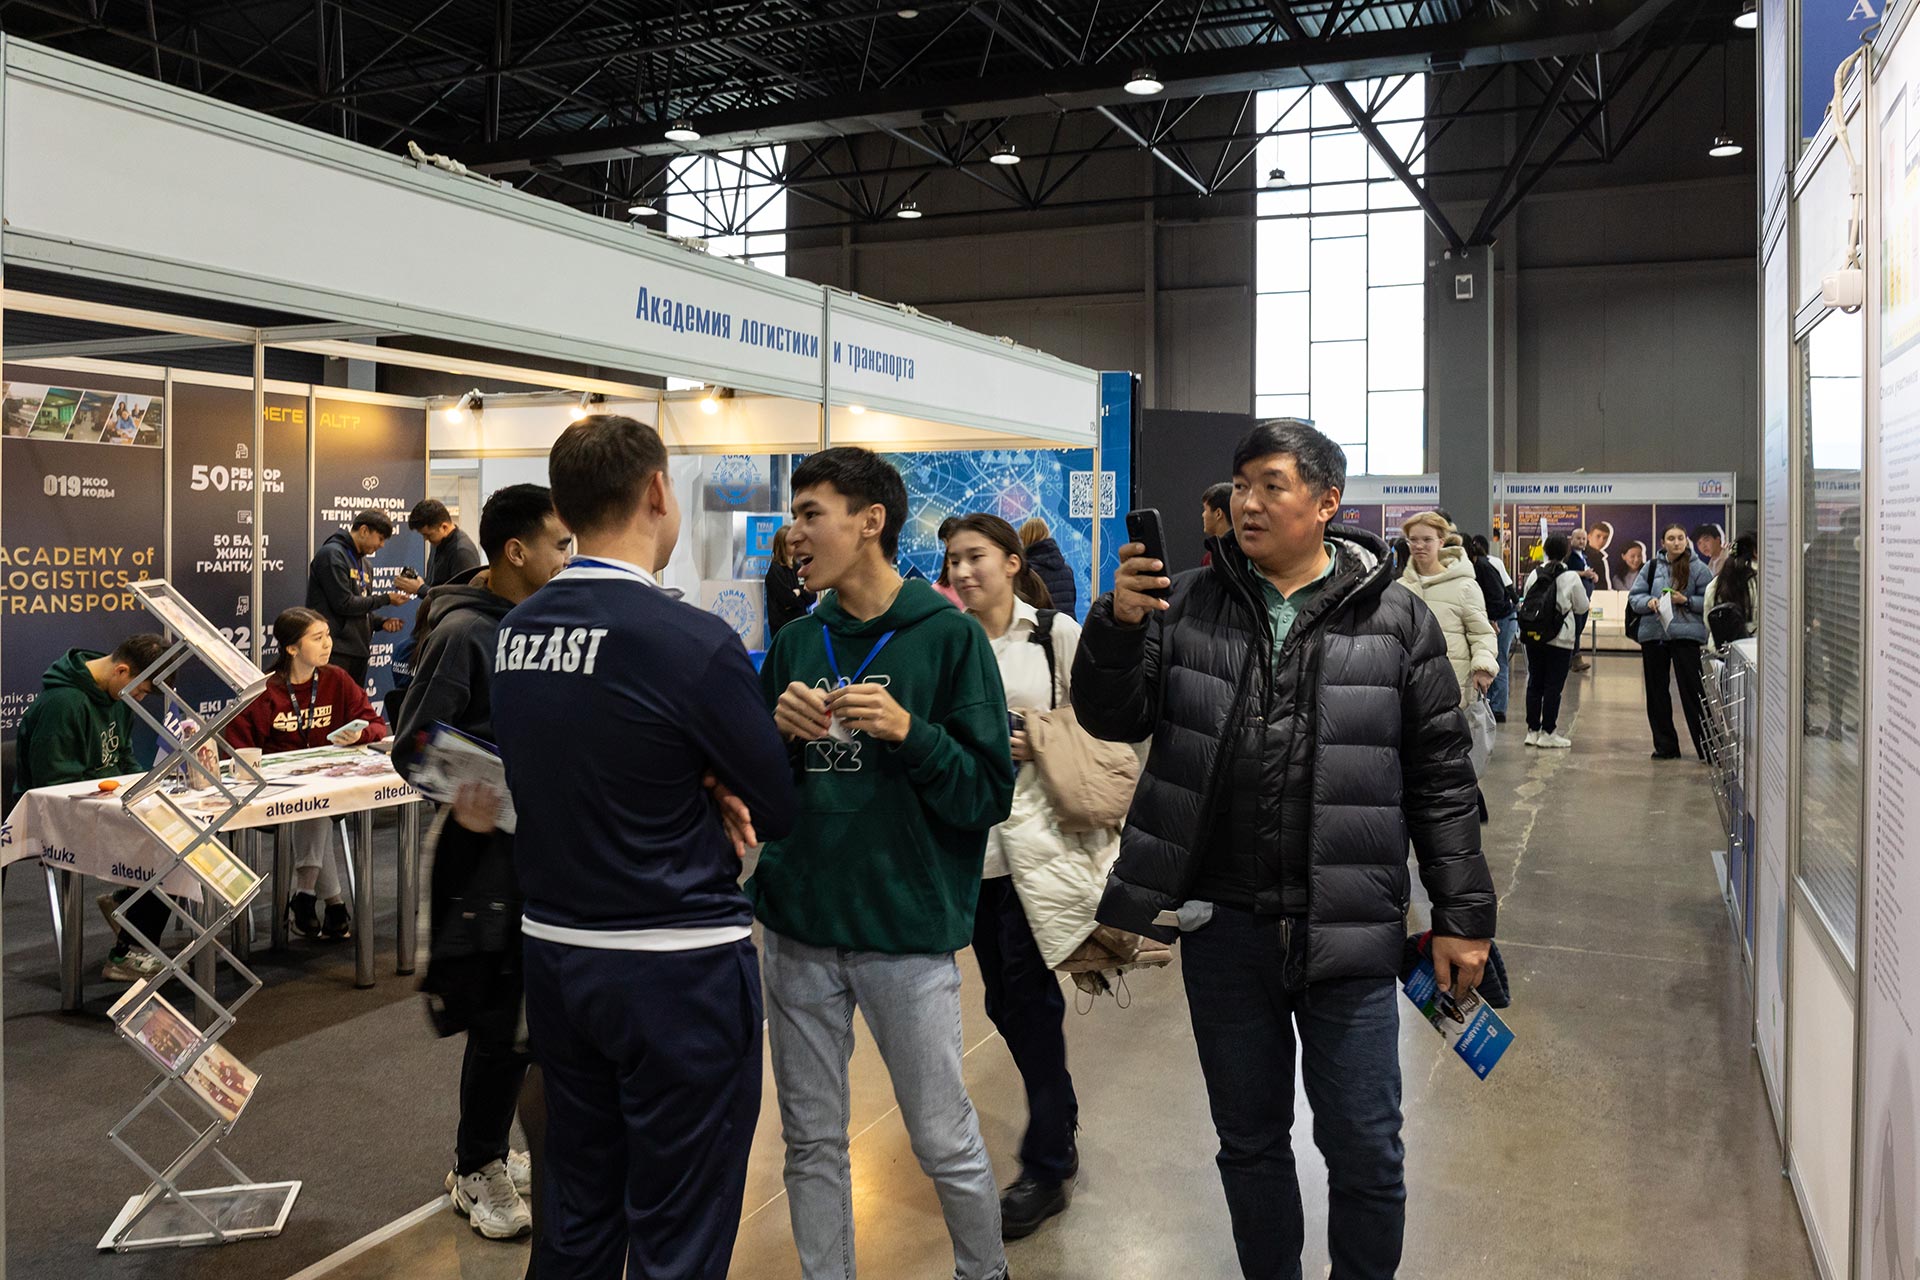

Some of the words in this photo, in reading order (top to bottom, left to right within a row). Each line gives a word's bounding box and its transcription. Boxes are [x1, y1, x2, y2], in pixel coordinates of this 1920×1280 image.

[636, 286, 731, 340] Академия
[739, 318, 819, 358] логистики
[833, 340, 841, 364] и
[848, 344, 915, 382] транспорта
[44, 474, 81, 497] 019
[190, 465, 230, 491] 50
[1507, 485, 1541, 494] TOURISM
[1543, 485, 1560, 494] AND
[1563, 485, 1613, 493] HOSPITALITY
[334, 497, 405, 509] FOUNDATION
[321, 510, 353, 521] ТЕГІН
[213, 535, 230, 546] 50
[233, 535, 269, 546] БАЛ
[0, 547, 124, 566] ACADEMY
[132, 547, 154, 566] of
[494, 626, 609, 675] KazAST
[375, 783, 422, 801] altedu
[266, 796, 331, 817] altedukz
[112, 861, 157, 882] alteduk
